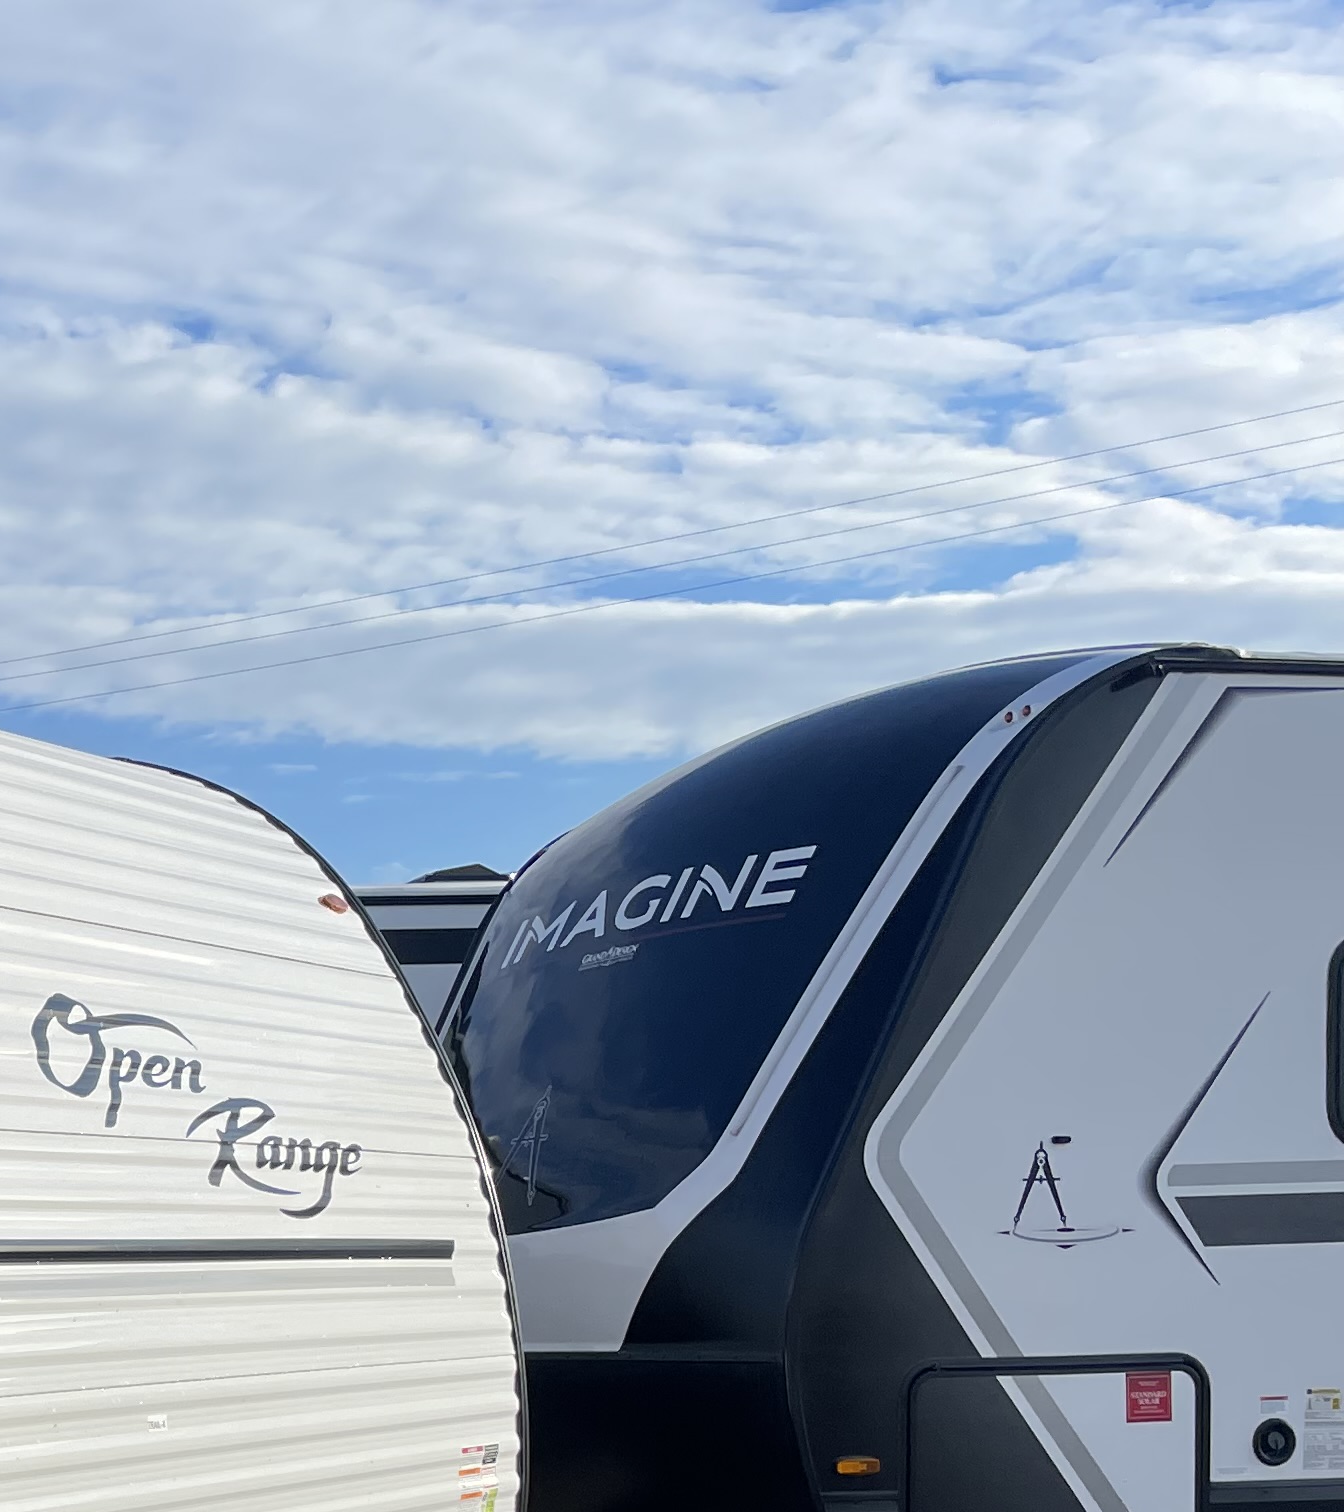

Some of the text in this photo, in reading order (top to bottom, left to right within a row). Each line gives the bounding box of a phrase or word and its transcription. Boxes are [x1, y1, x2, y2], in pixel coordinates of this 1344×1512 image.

[501, 845, 817, 969] IMAGINE
[30, 993, 207, 1128] Open
[186, 1097, 363, 1219] Range
